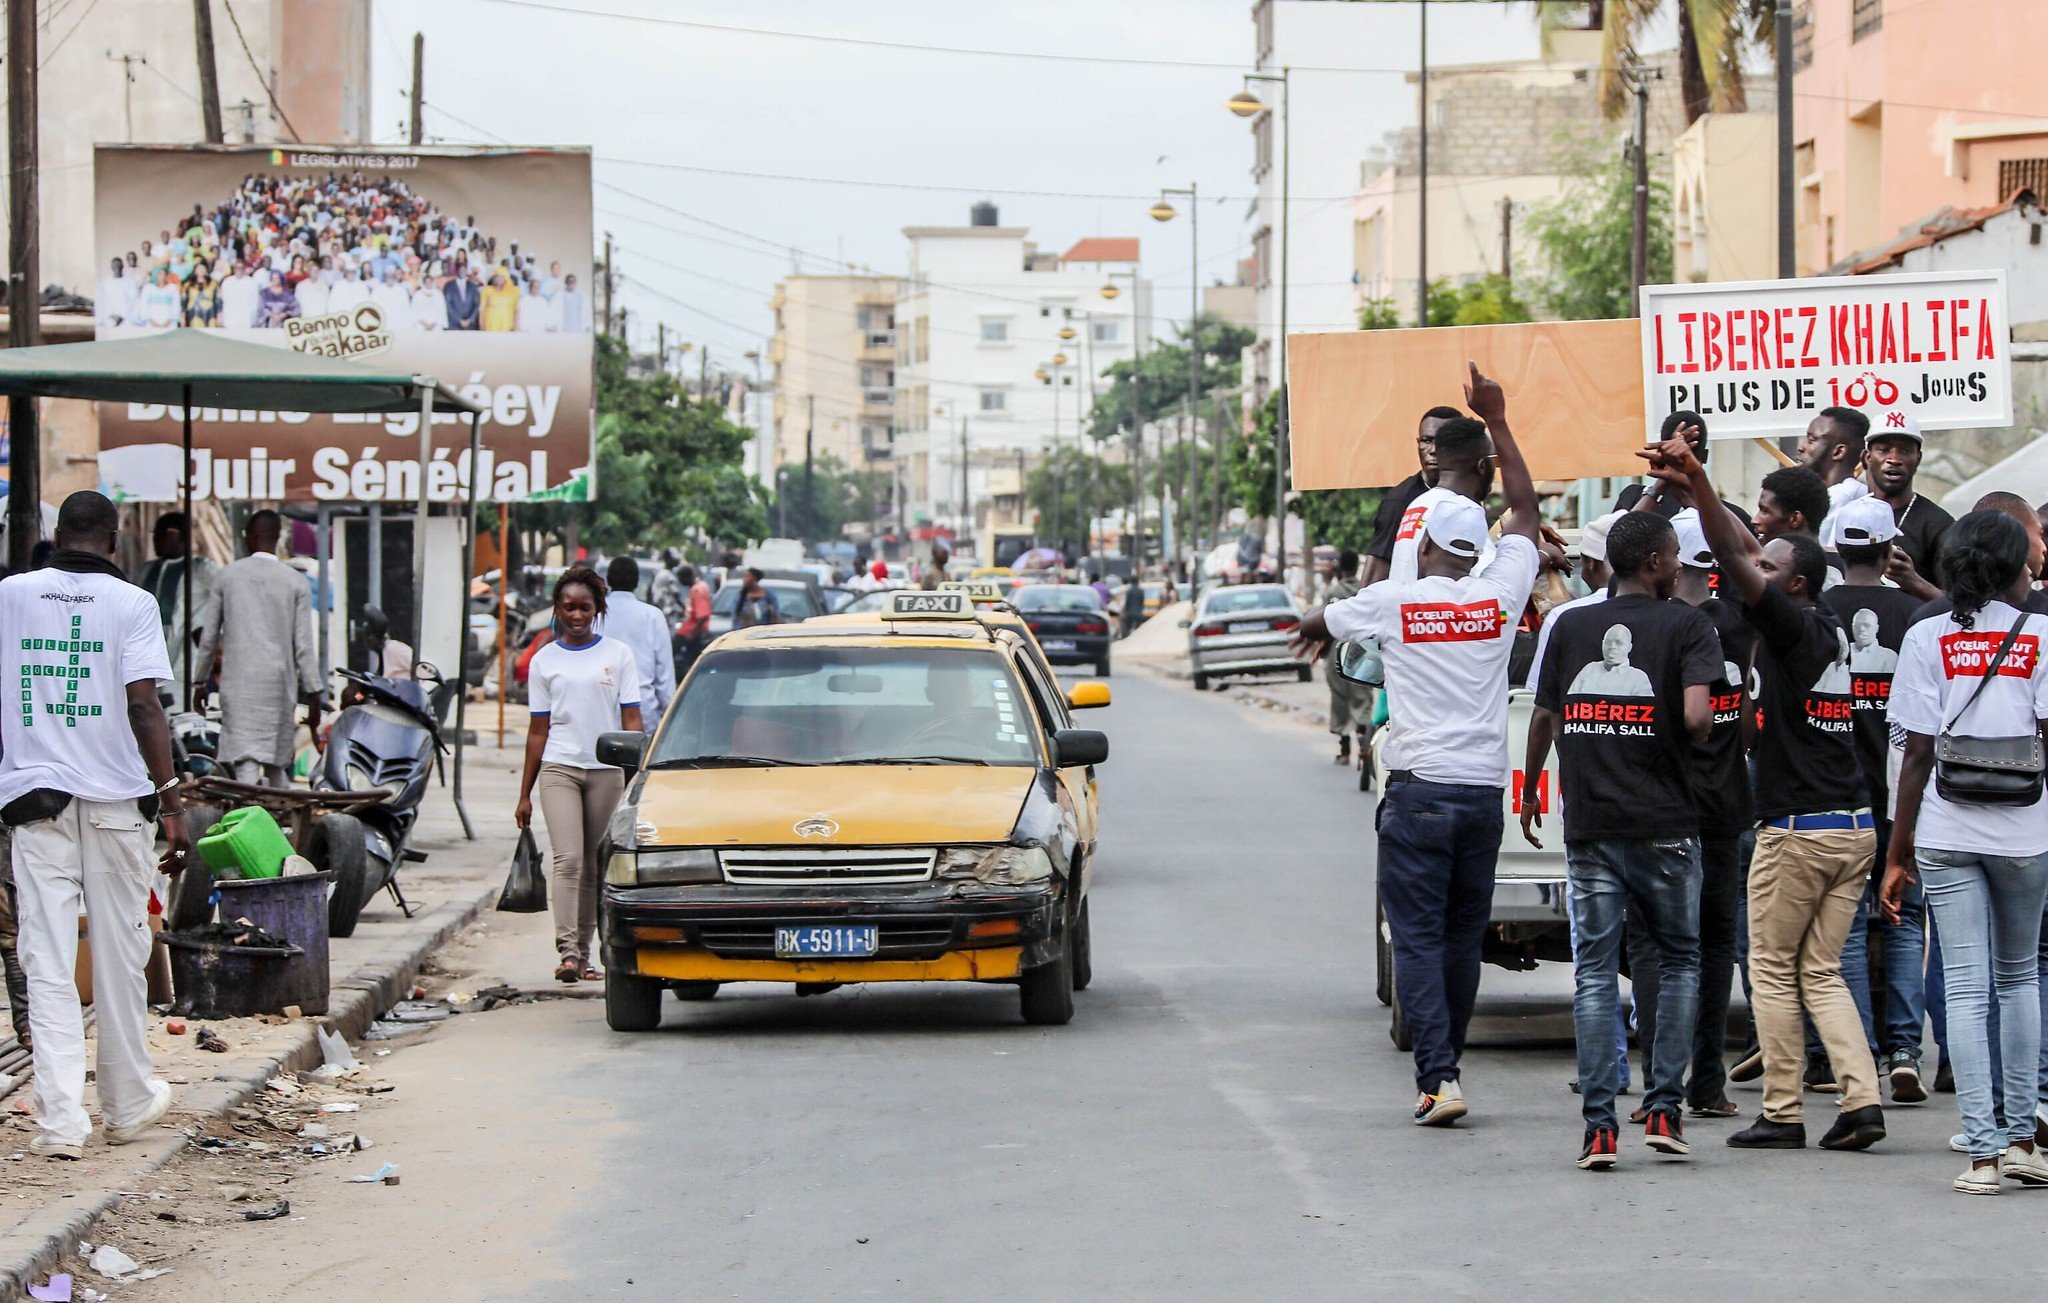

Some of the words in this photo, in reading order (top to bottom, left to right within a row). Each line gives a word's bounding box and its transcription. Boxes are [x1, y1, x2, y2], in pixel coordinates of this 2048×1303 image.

[387, 156, 419, 169] 2017
[288, 315, 349, 337] Benno
[1655, 306, 1820, 374] LIBEREZ
[1830, 299, 1995, 366] KHALIFA
[1670, 381, 1760, 415] PLUS
[1771, 378, 1815, 410] DE
[897, 596, 958, 611] TAXI
[1408, 621, 1447, 635] 1000
[1450, 619, 1497, 634] VOIX
[22, 639, 102, 652] CULTURE
[22, 665, 89, 678] SOCIAL
[22, 665, 32, 726] SANTE
[47, 704, 102, 716] SPORT
[1564, 700, 1655, 722] LIBÉREZ
[1713, 710, 1740, 724] SALL
[1619, 725, 1656, 736] SALL
[778, 928, 876, 953] DK-5911-U
